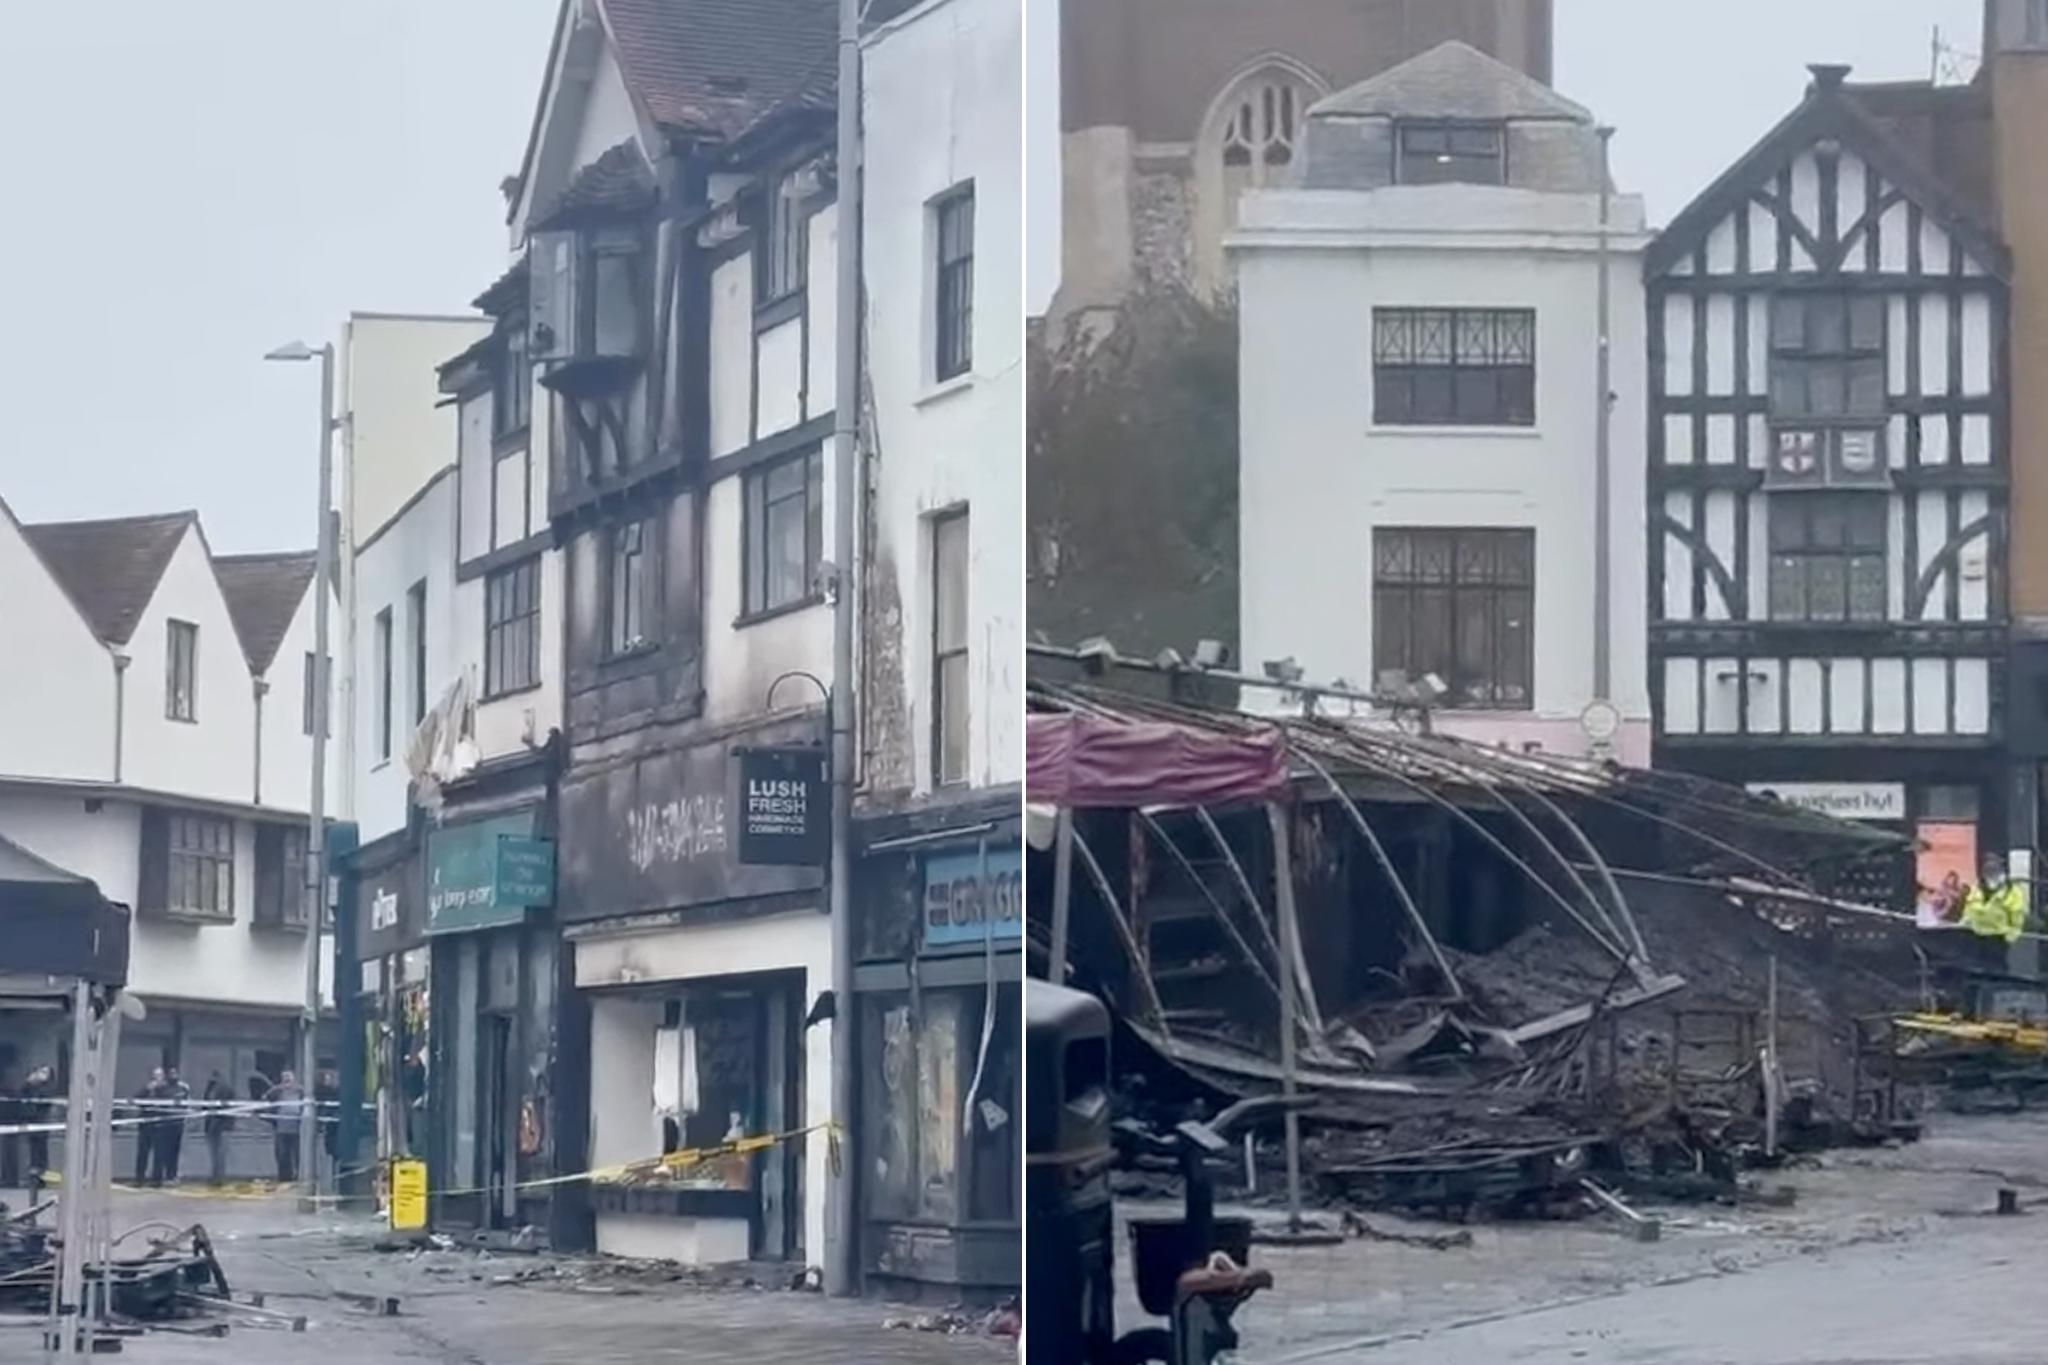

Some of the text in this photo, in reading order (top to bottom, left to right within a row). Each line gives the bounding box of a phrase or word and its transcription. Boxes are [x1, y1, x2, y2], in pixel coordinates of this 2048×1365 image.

[749, 779, 806, 797] LUSH
[749, 797, 806, 813] FRESH
[748, 824, 805, 834] COSMETICS
